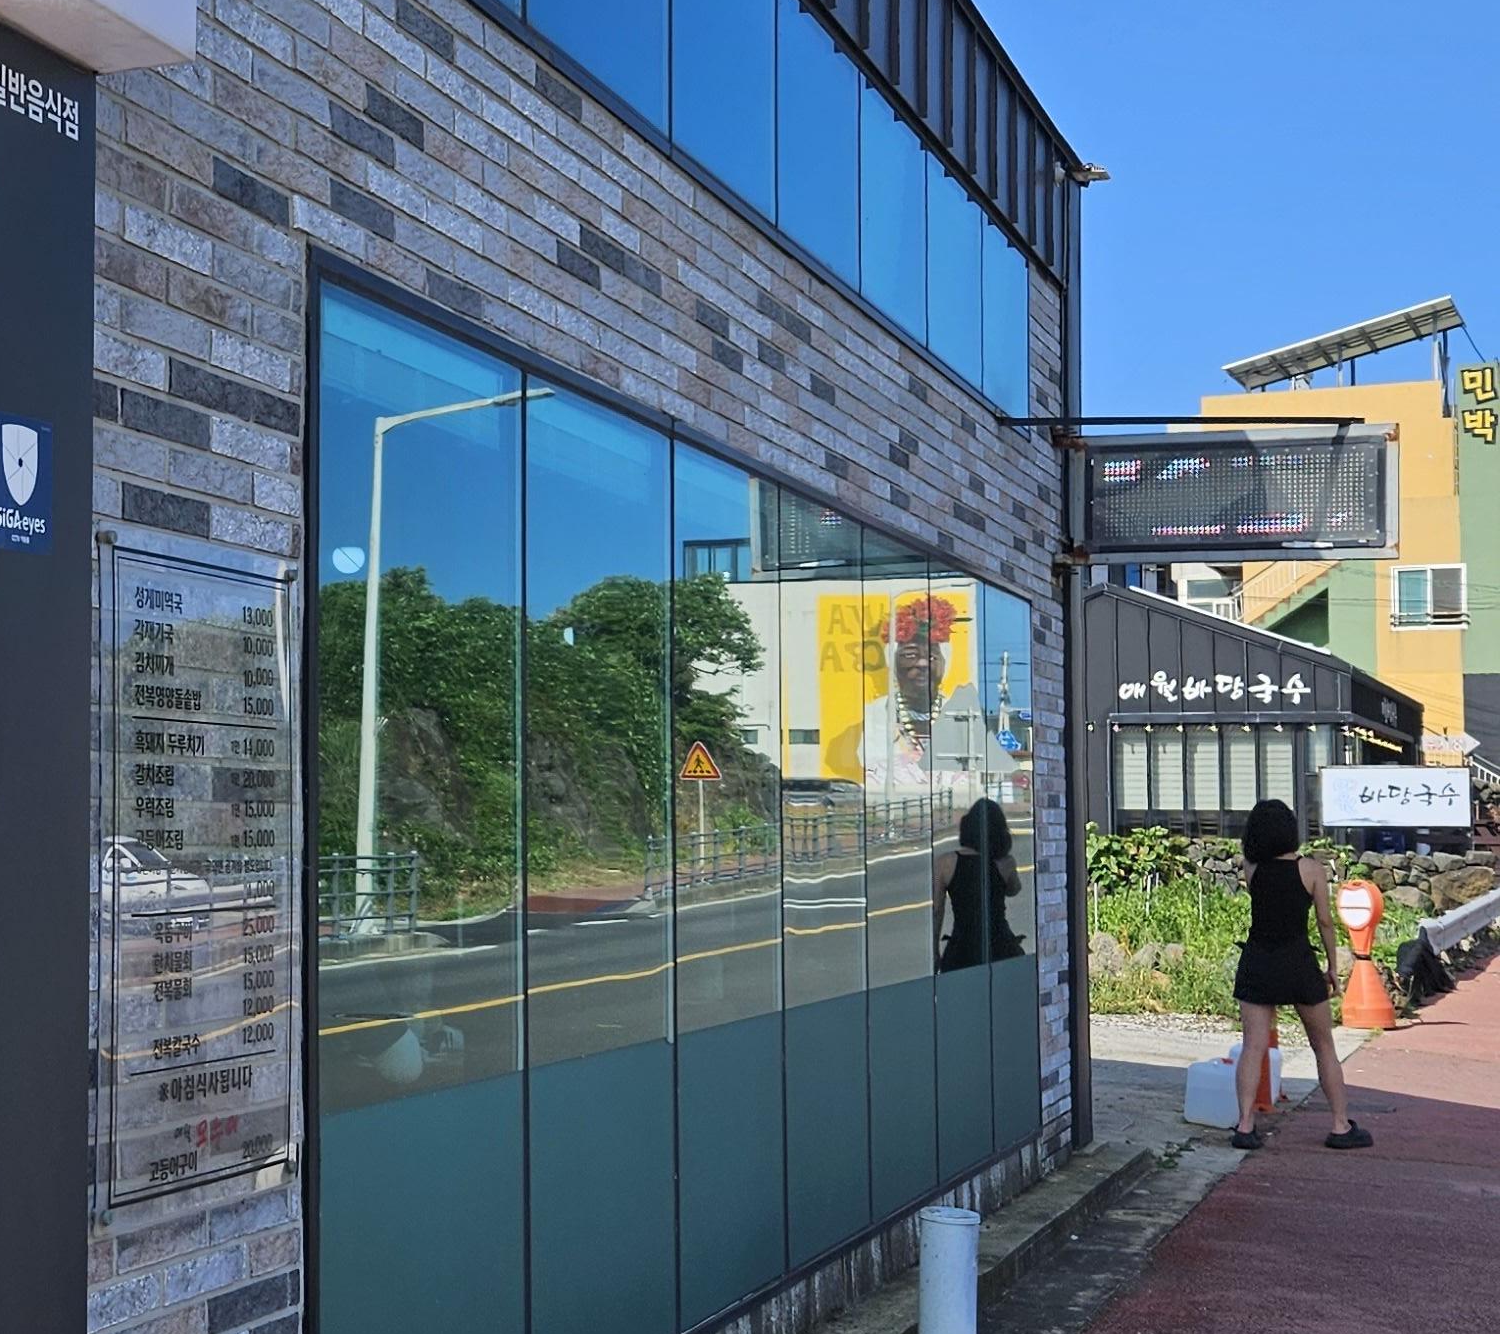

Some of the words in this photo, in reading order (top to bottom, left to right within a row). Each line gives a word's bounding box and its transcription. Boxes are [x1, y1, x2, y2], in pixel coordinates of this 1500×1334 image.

[1460, 367, 1498, 445] 민박
[135, 586, 183, 614] 성게미역국
[241, 606, 273, 628] 13,000
[242, 636, 274, 659] 10,000
[243, 667, 274, 689] 10,000
[243, 696, 274, 717] 15,000
[166, 732, 205, 757] 두루치기
[135, 763, 175, 787] 갈치조림
[135, 796, 175, 819] 우럭조림
[244, 800, 275, 819] 15,000
[243, 829, 275, 850] 15,000
[243, 945, 275, 967] 15,000
[153, 978, 193, 1003] 전복물회
[243, 970, 275, 991] 15,000
[242, 995, 275, 1017] 12,000
[153, 1034, 201, 1060] 전복칼국수
[242, 1023, 275, 1046] 12,000
[149, 1151, 198, 1182] 고등어구이
